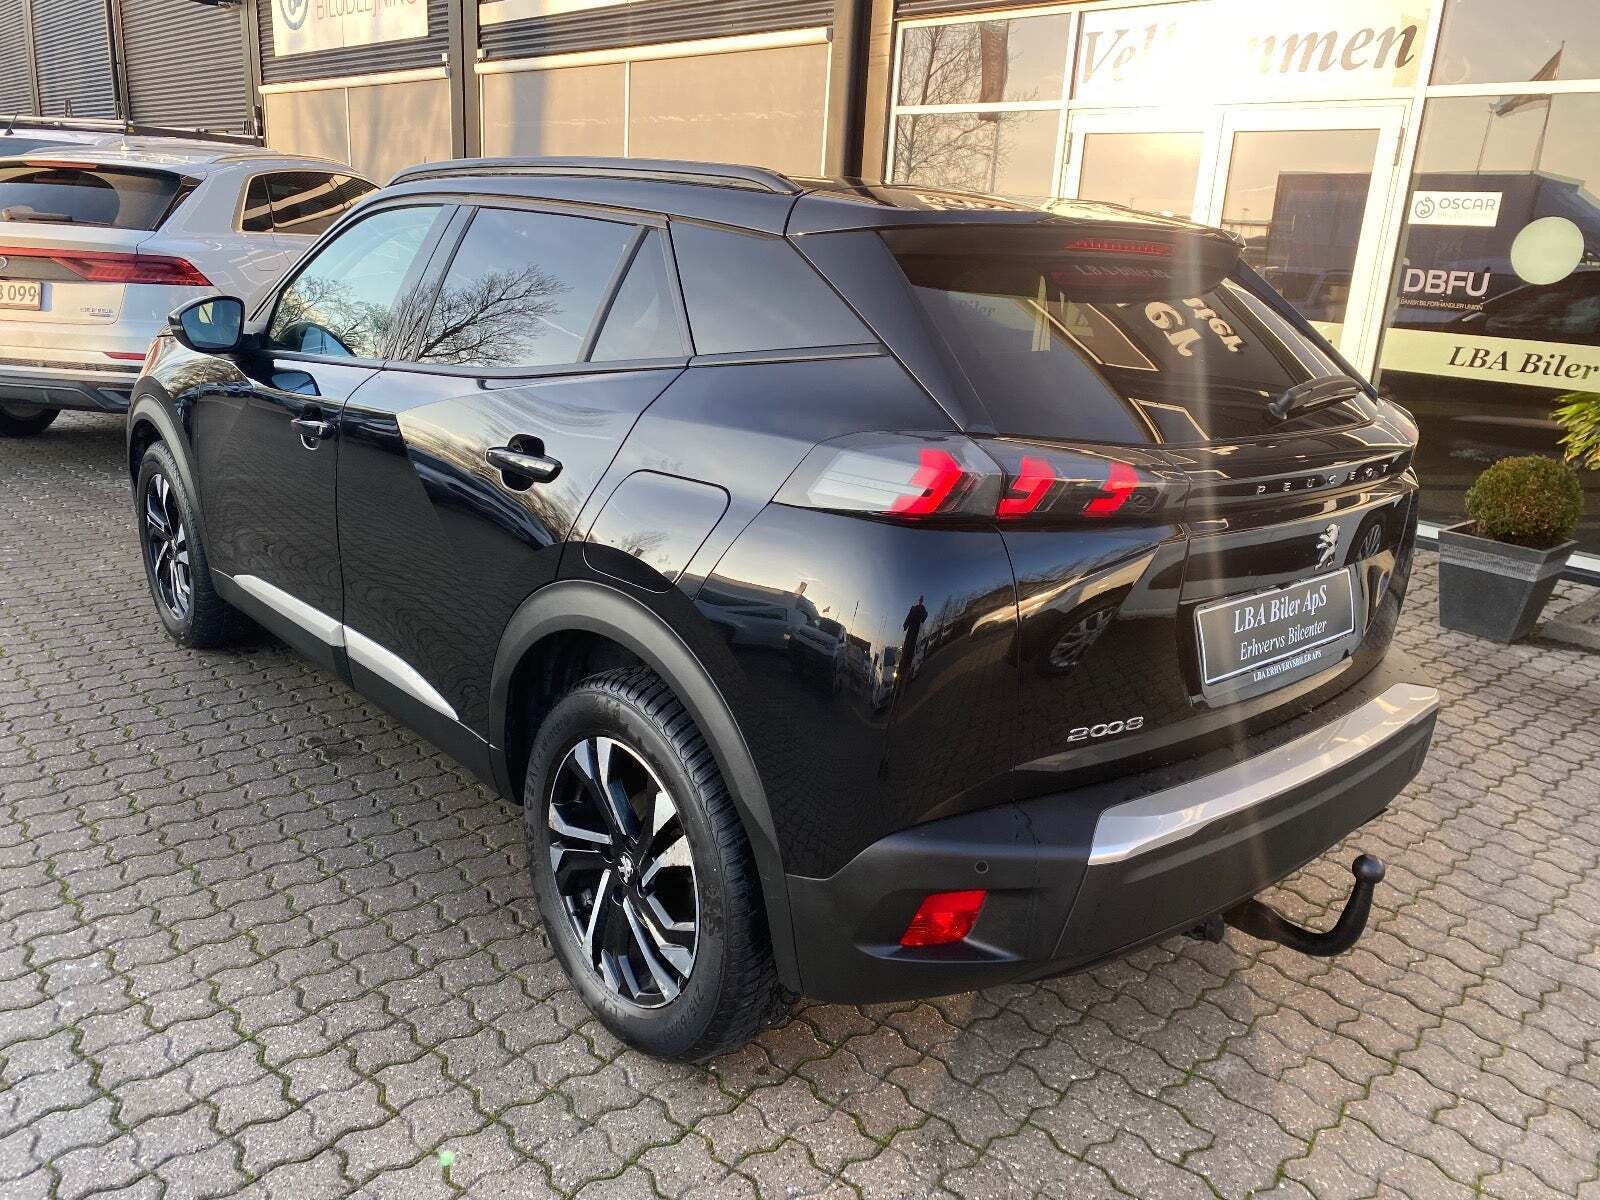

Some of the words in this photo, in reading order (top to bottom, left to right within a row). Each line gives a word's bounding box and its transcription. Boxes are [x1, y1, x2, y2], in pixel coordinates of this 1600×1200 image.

[1439, 197, 1497, 211] OSCAR
[1403, 268, 1491, 297] DBFU
[1447, 346, 1509, 371] LBA
[1517, 352, 1600, 380] Biler
[1233, 602, 1267, 634] LBA
[1269, 595, 1301, 623] Biler
[1302, 584, 1328, 616] ApS
[1240, 635, 1286, 661] Erhvervs
[1288, 620, 1328, 645] Bilcenter
[1253, 670, 1266, 682] LBA
[1066, 716, 1144, 743] 2008
